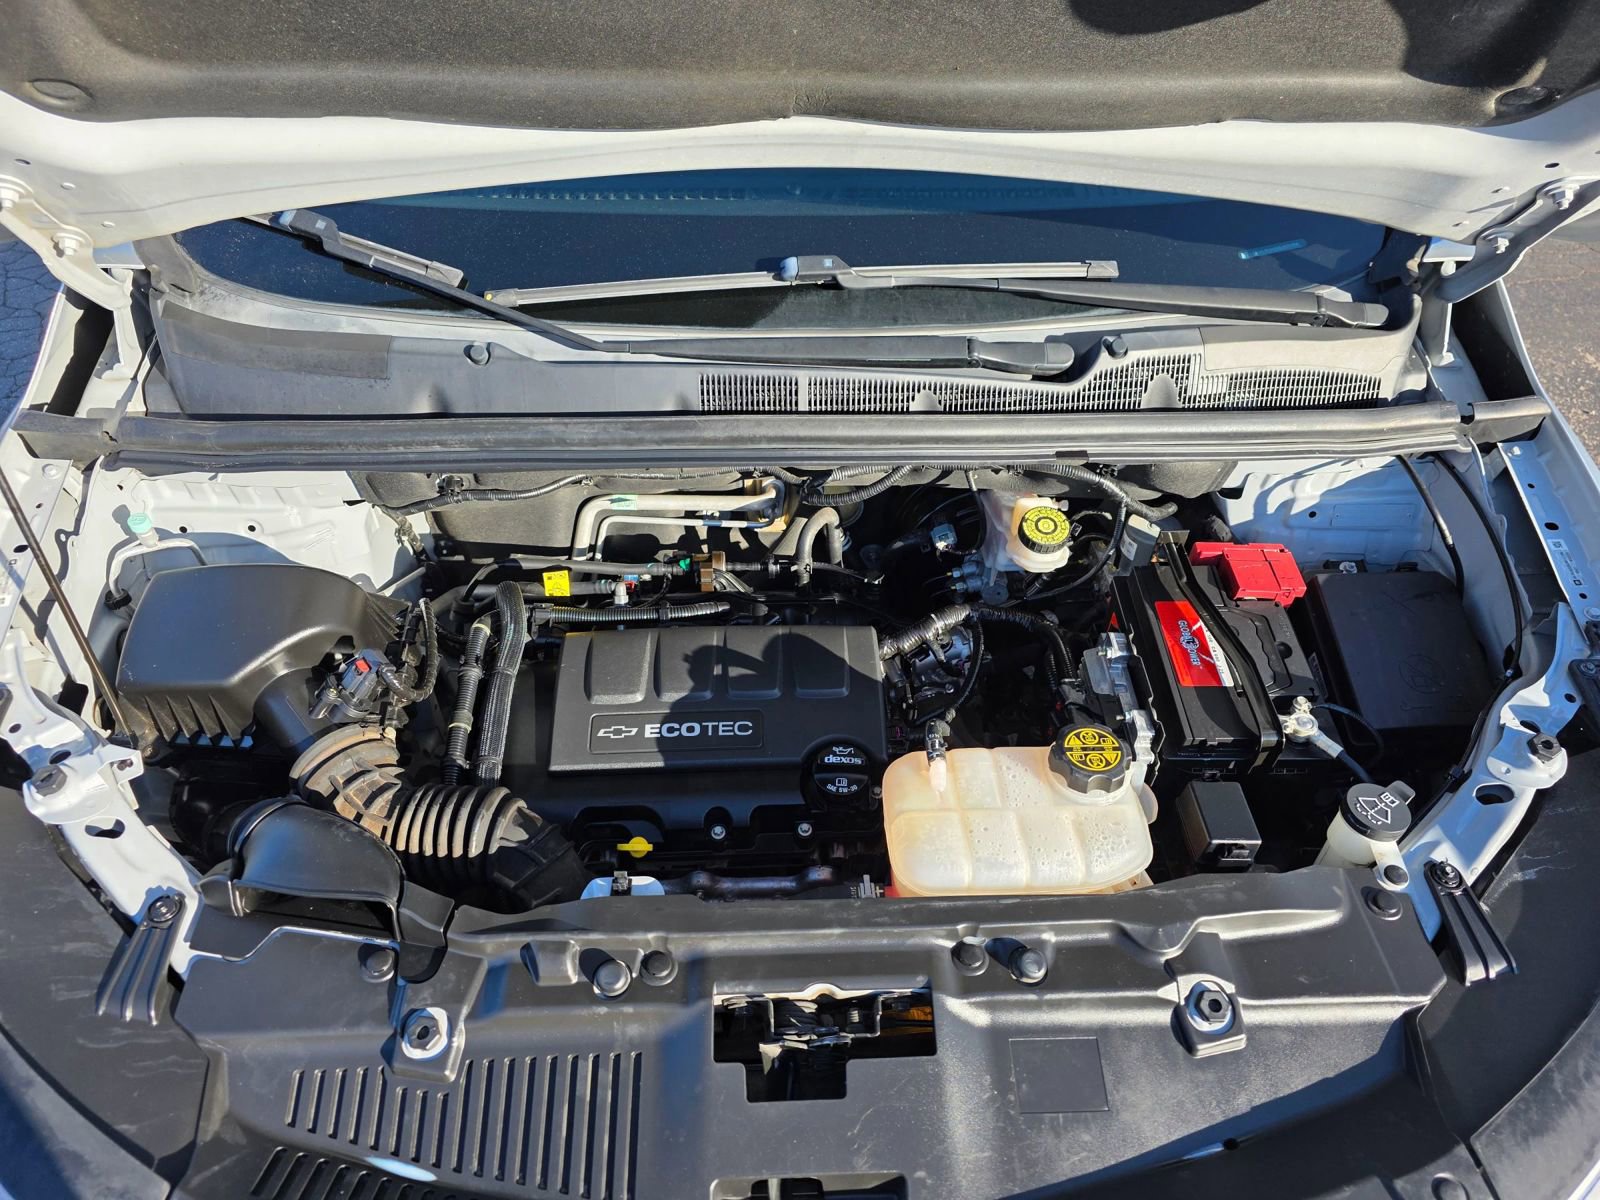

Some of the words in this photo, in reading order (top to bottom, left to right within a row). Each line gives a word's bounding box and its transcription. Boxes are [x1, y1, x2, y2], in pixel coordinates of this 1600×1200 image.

[1178, 620, 1195, 642] GLOBAL
[1184, 641, 1200, 665] POWER
[644, 720, 753, 738] ECOTEC
[824, 754, 862, 764] dexos
[826, 783, 837, 792] SAE
[838, 784, 858, 792] 5W-30
